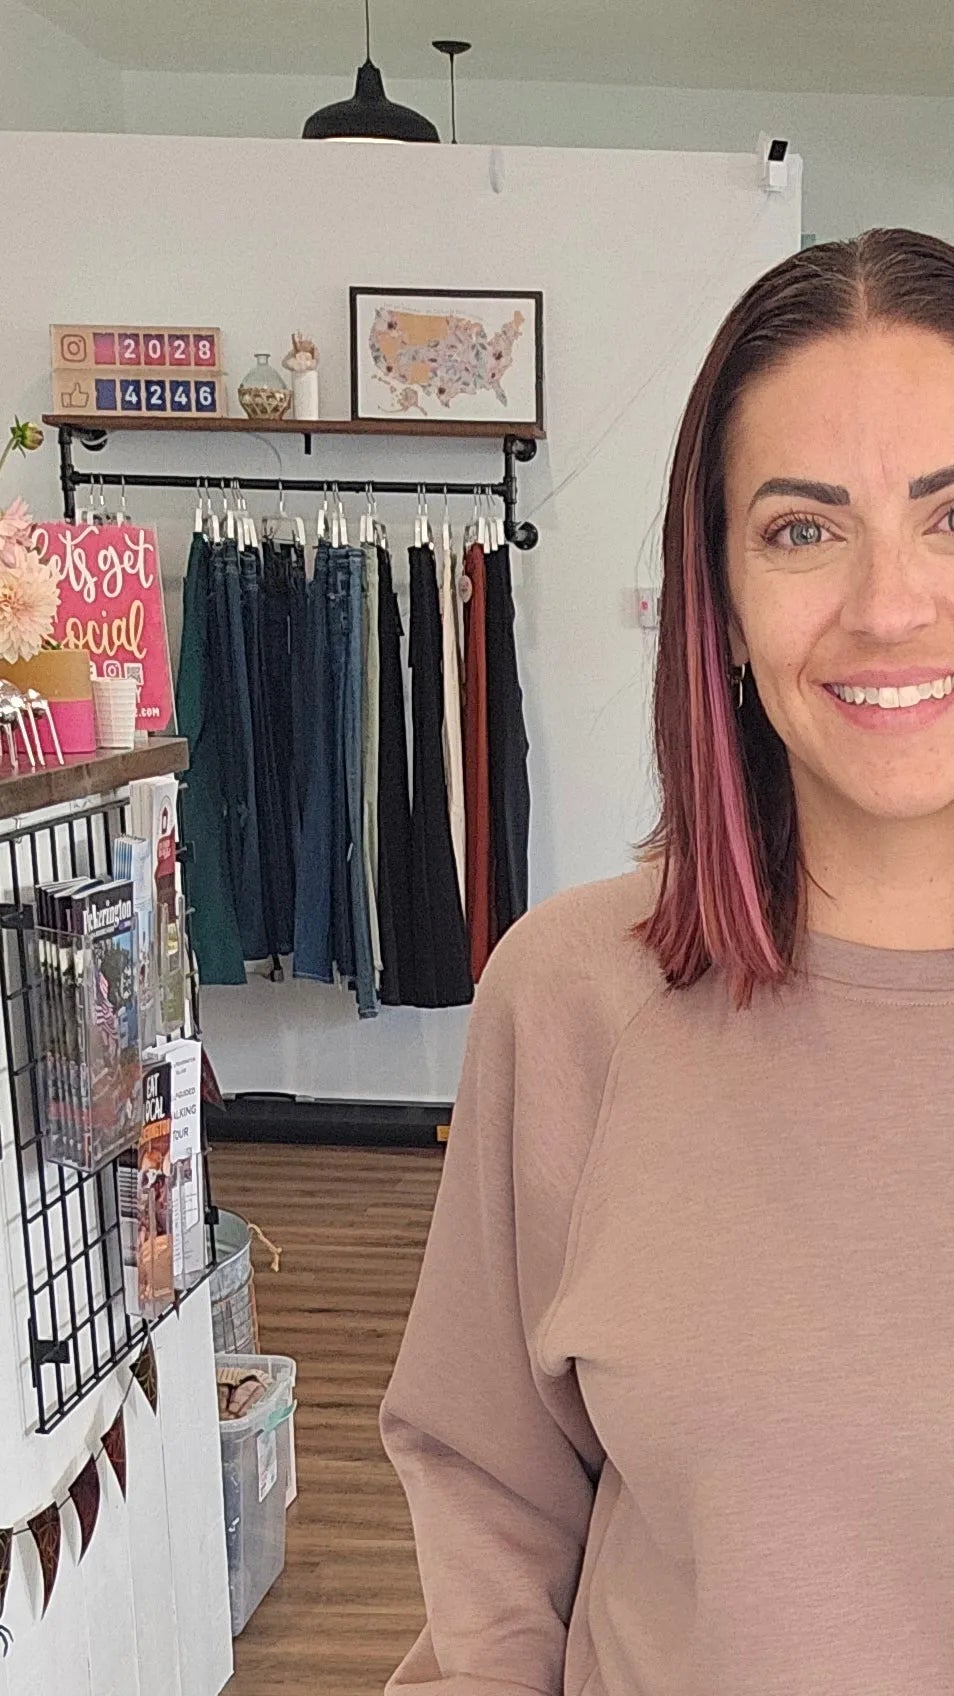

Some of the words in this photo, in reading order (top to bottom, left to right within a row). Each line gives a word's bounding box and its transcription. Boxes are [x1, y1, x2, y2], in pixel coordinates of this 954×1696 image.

[123, 339, 211, 359] 2028
[124, 385, 212, 405] 4246
[98, 529, 154, 598] get
[52, 599, 147, 660] ocial
[146, 1072, 160, 1099] EAT
[143, 1096, 165, 1125] OCAL
